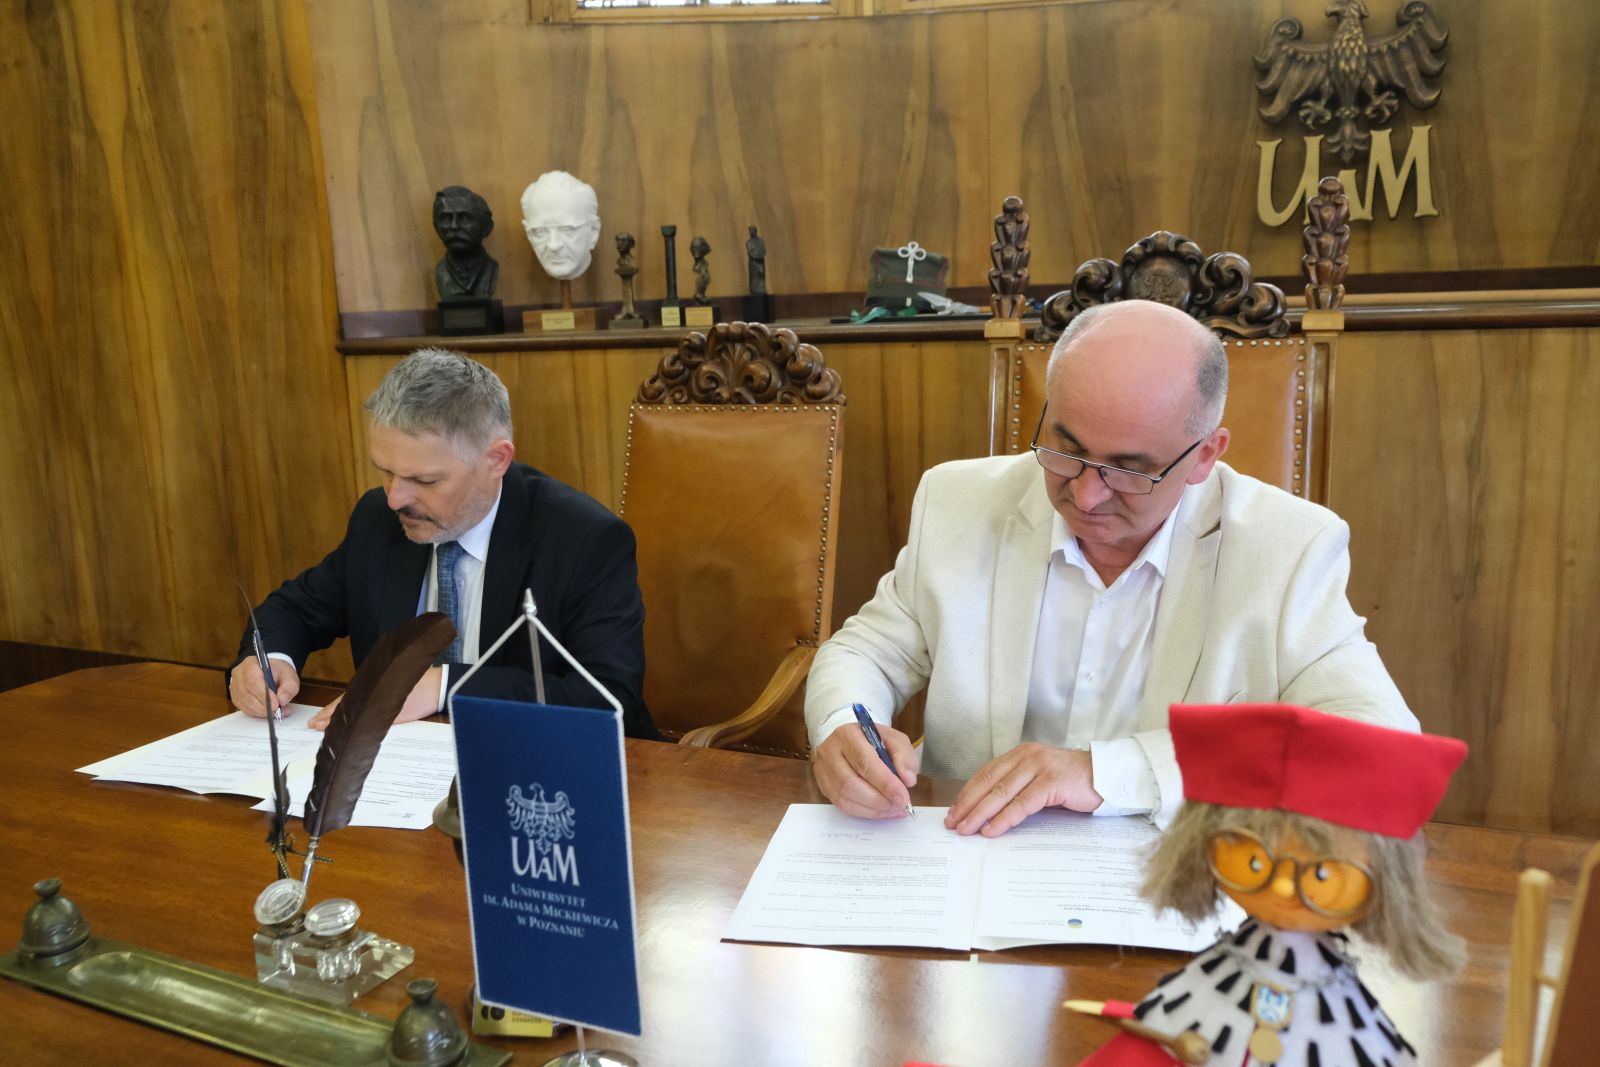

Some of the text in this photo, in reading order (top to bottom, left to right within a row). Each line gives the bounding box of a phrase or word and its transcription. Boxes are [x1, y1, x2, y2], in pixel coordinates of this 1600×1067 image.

[511, 837, 580, 886] UAM
[511, 883, 587, 908] UNIWERSYTET
[483, 894, 619, 930] IM. ADAMA MICKIEWICZA
[529, 917, 585, 938] POZNANIU
